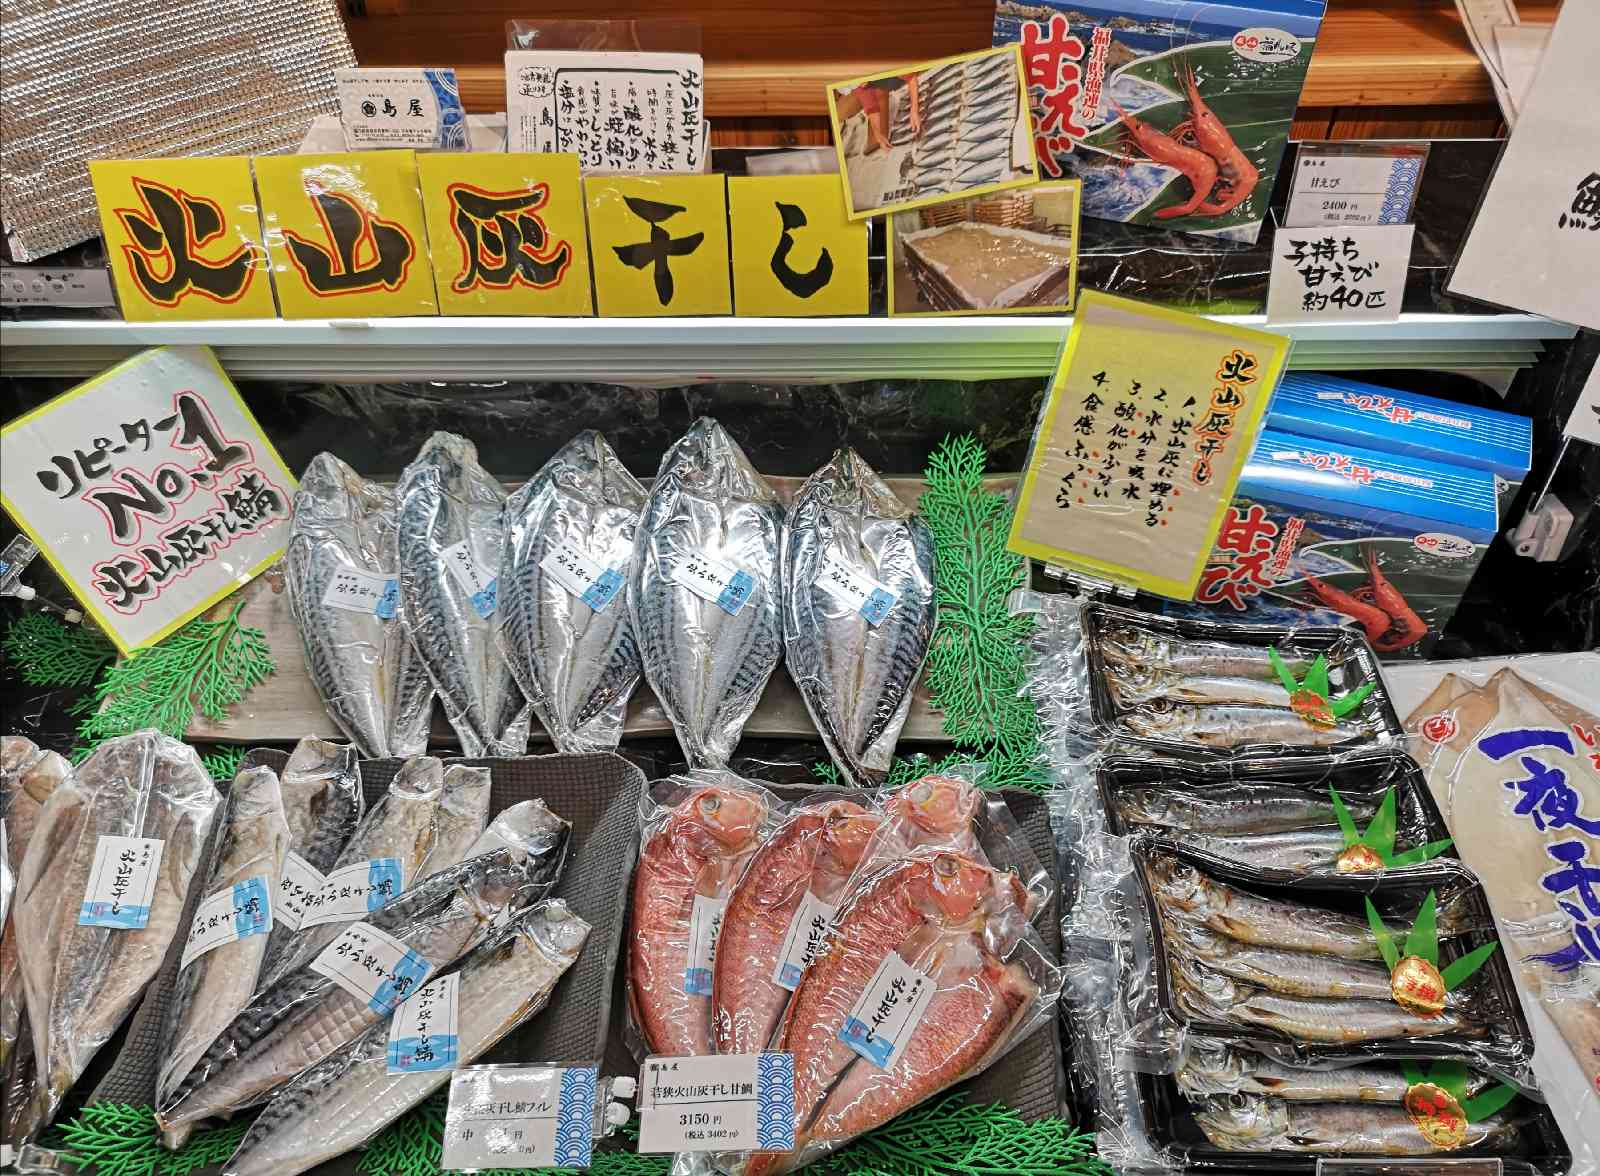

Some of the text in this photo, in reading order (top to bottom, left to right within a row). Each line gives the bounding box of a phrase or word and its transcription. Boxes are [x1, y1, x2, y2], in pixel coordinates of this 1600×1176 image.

[1311, 177, 1341, 188] 甘えび
[1283, 236, 1360, 266] 子持ち
[1298, 261, 1380, 288] 甘えび
[1302, 286, 1387, 312] 約40匹
[1193, 351, 1257, 486] 火山灰干し
[36, 413, 180, 500] リピーター
[680, 1113, 709, 1125] 3150
